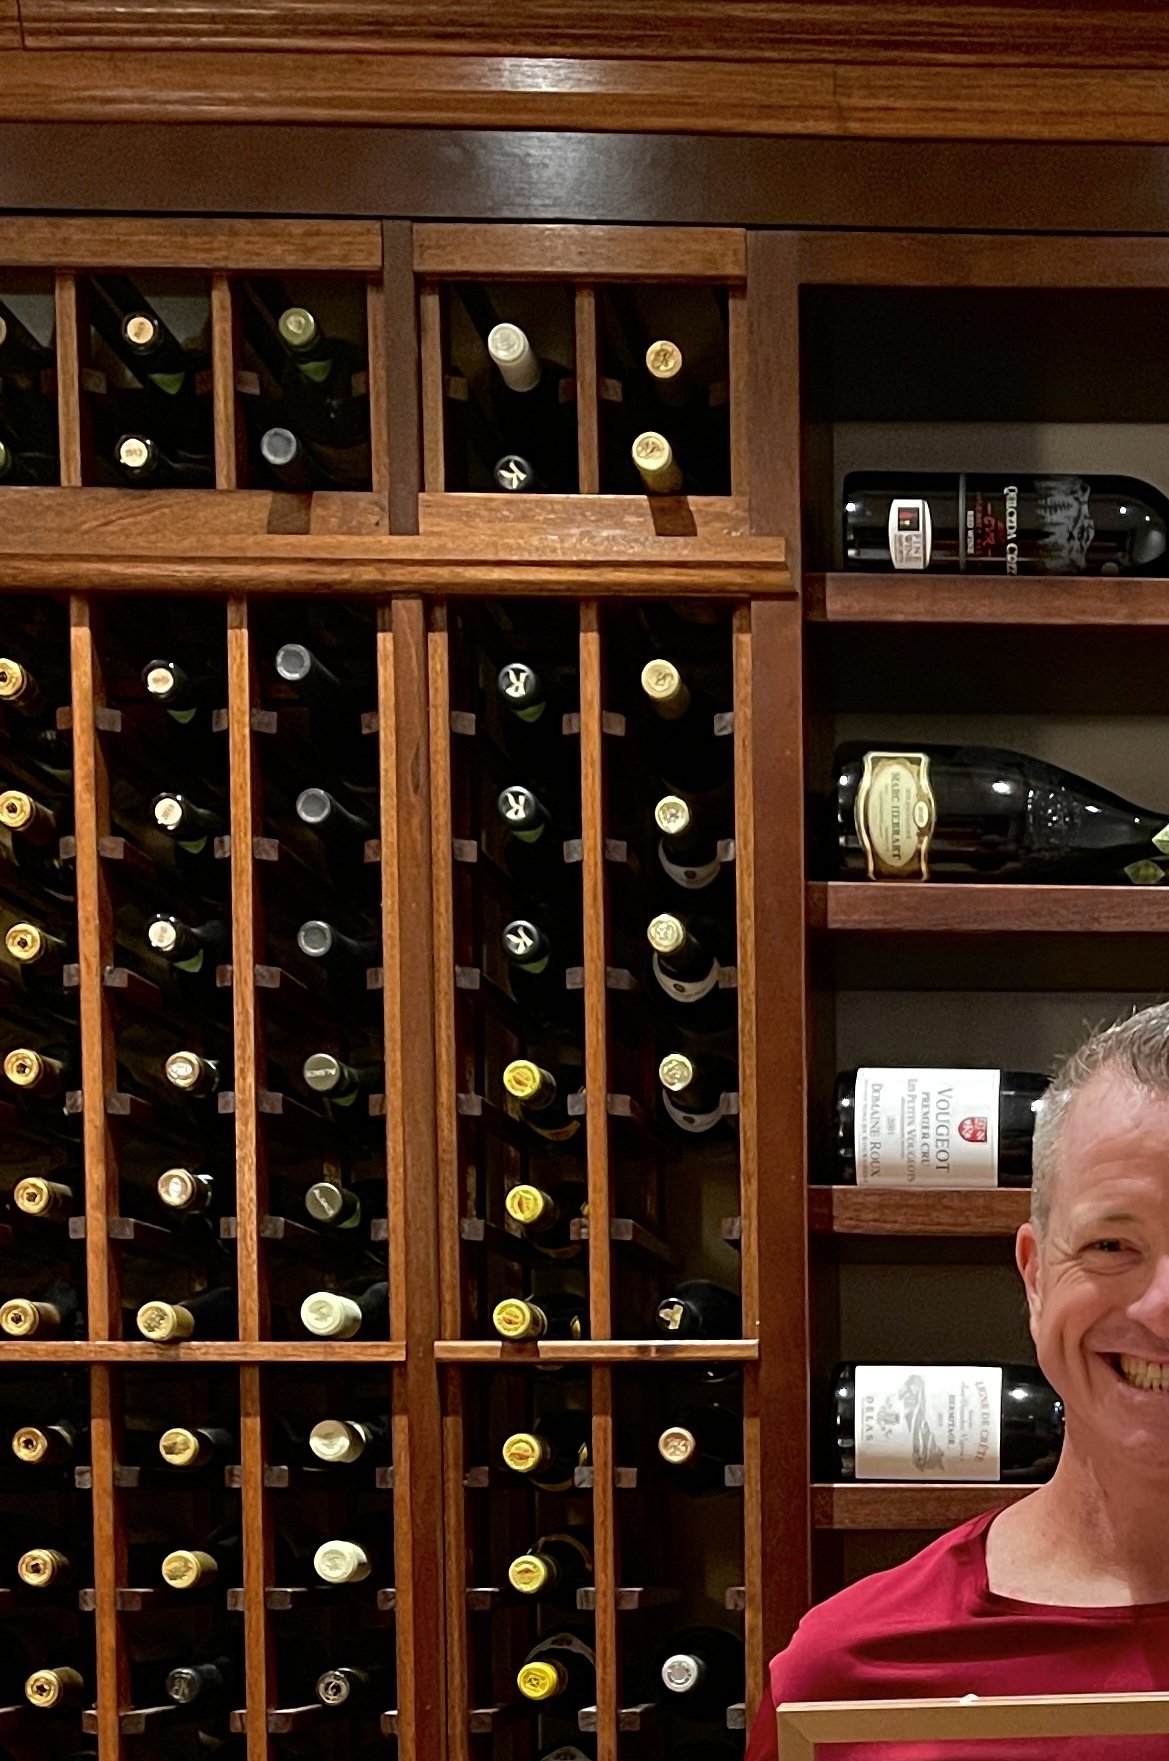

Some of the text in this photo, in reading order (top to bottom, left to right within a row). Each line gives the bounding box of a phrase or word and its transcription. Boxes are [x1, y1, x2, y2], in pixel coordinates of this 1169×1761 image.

[869, 1082, 883, 1178] DOMAINE ROUX
[906, 1128, 916, 1183] VOUGEOTS
[920, 1091, 930, 1168] PREMIER CRU
[934, 1087, 953, 1174] VOUGEOT
[864, 1395, 873, 1442] DELAS
[980, 1411, 989, 1428] DE
